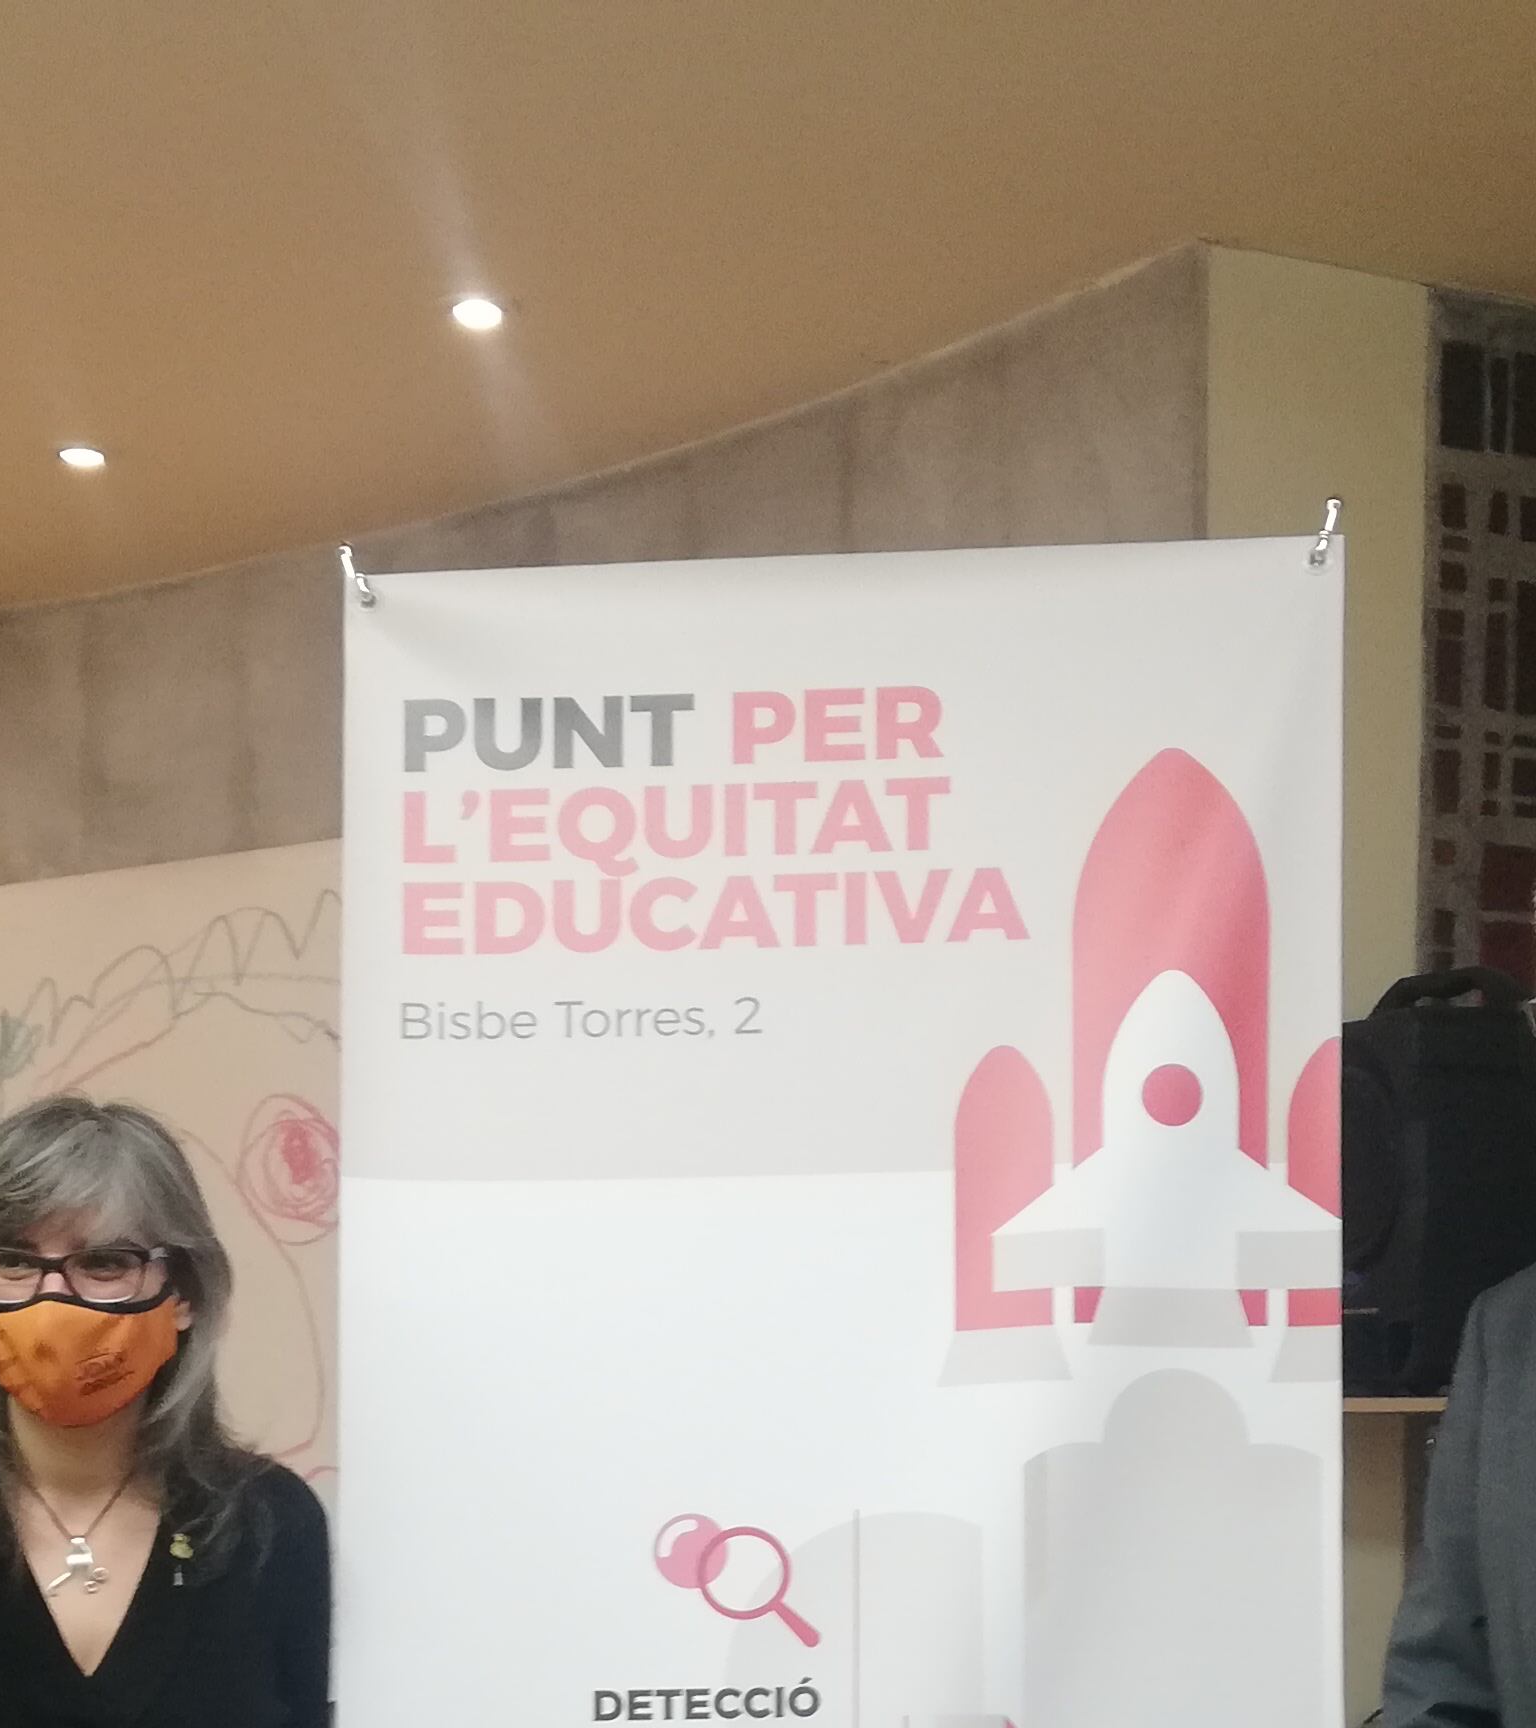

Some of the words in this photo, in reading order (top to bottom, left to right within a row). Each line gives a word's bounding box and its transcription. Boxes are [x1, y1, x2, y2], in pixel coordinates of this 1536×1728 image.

[404, 693, 695, 772] PUNT
[732, 685, 944, 764] PER
[403, 776, 952, 878] L'EQUITAT
[402, 866, 1031, 955] EDUCATIVA
[401, 1001, 537, 1040] Bisbe
[554, 1001, 715, 1038] Torres,
[734, 997, 763, 1035] 2
[594, 1677, 820, 1721] DETECCIÓ
